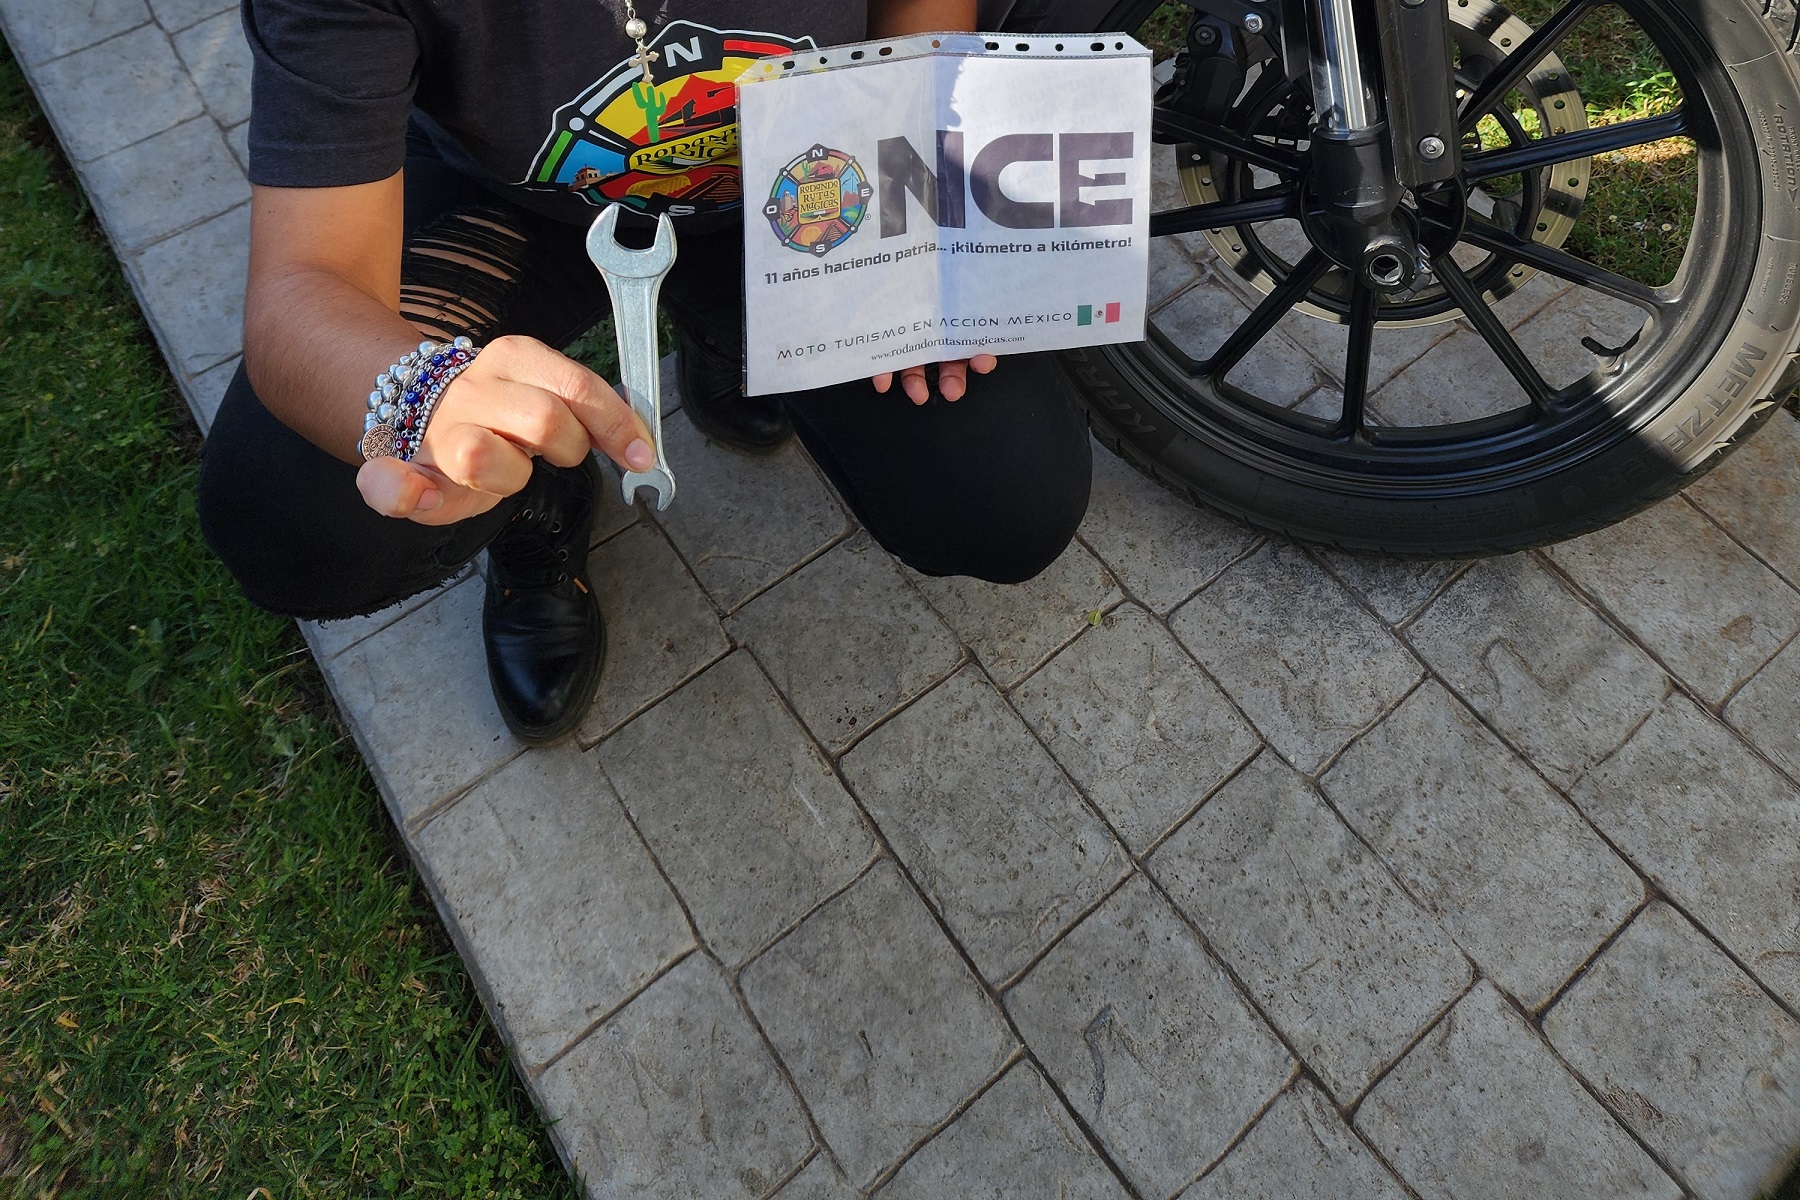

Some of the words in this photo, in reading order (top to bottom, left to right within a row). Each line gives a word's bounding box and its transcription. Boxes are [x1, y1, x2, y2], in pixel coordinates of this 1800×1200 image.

[664, 36, 703, 68] N
[1773, 114, 1797, 186] ROTATION
[764, 272, 778, 285] 11
[782, 266, 820, 283] años
[824, 253, 891, 274] haciendo
[895, 242, 947, 263] patria...
[951, 241, 1032, 255] ¡kilómetro
[1037, 244, 1047, 252] a
[1051, 236, 1132, 252] kilómetro!
[1780, 262, 1799, 305] TUBELESS
[777, 343, 826, 360] MOTO
[834, 325, 907, 349] TURISMO
[913, 318, 933, 332] EN
[939, 316, 999, 327] ACCIÓN
[1007, 313, 1073, 326] MÉXICO
[871, 336, 1025, 361] www.rodandorutasmagicas.com
